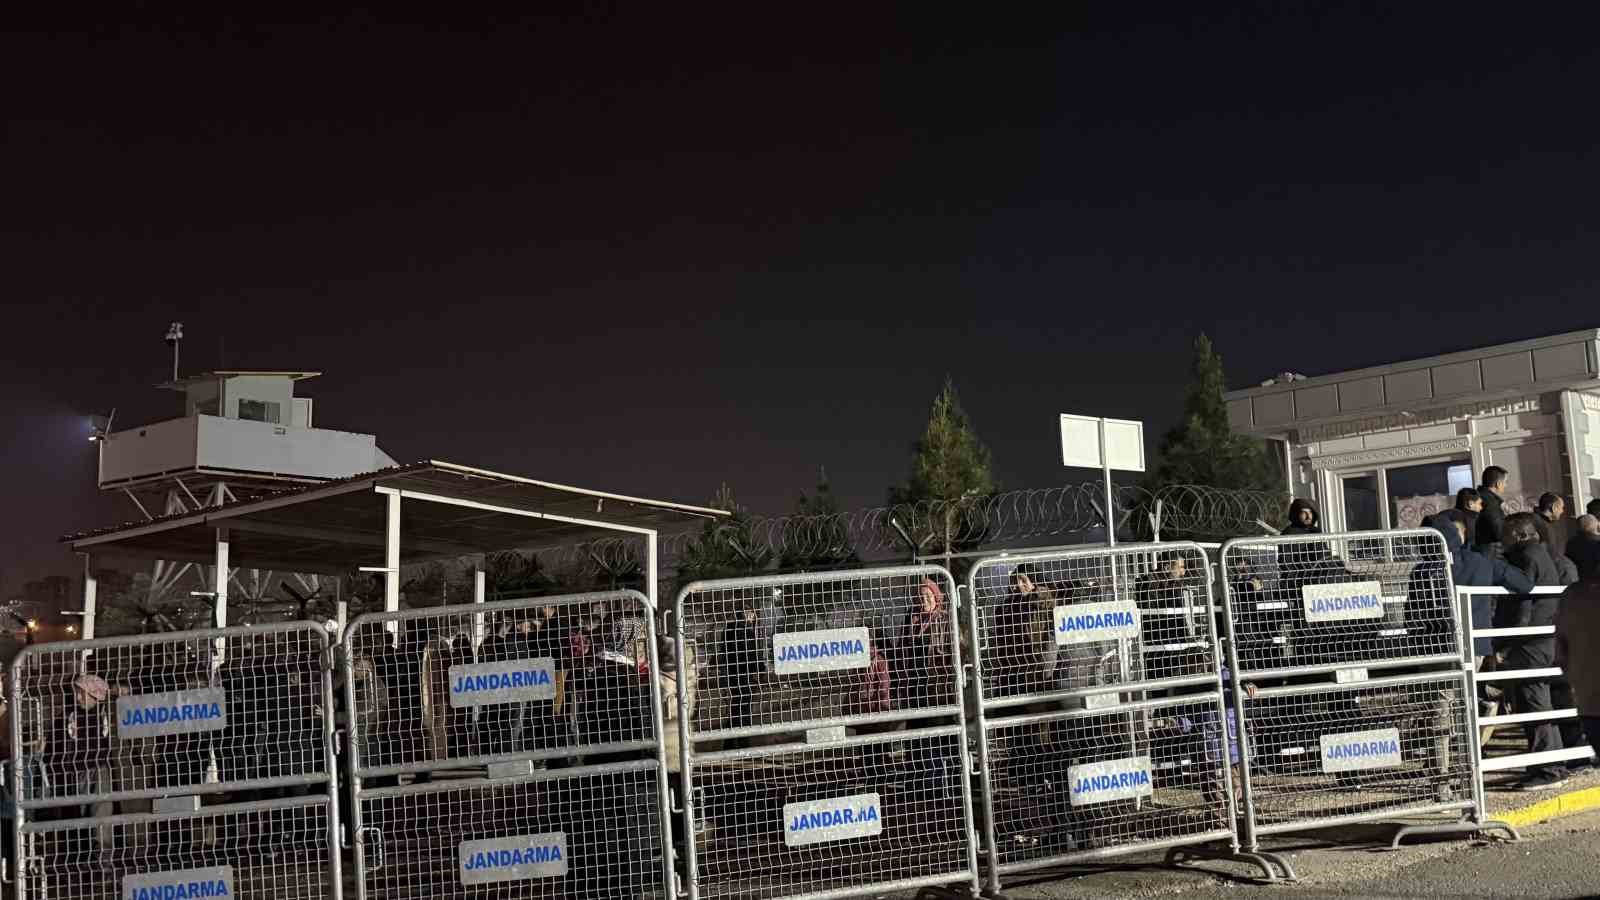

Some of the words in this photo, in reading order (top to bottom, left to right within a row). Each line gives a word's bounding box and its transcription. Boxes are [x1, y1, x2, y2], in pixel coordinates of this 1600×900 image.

[1308, 594, 1379, 614] JANDARMA
[1058, 611, 1134, 632] JANDARMA
[778, 640, 864, 661] JANDARMA
[453, 670, 550, 694] JANDARMA
[122, 702, 221, 727] JANDARMA
[1326, 740, 1397, 760] JANDARMA
[1074, 770, 1149, 793] JANDARMA
[464, 845, 561, 869] JANDARMA
[129, 880, 228, 900] JANDARMA
